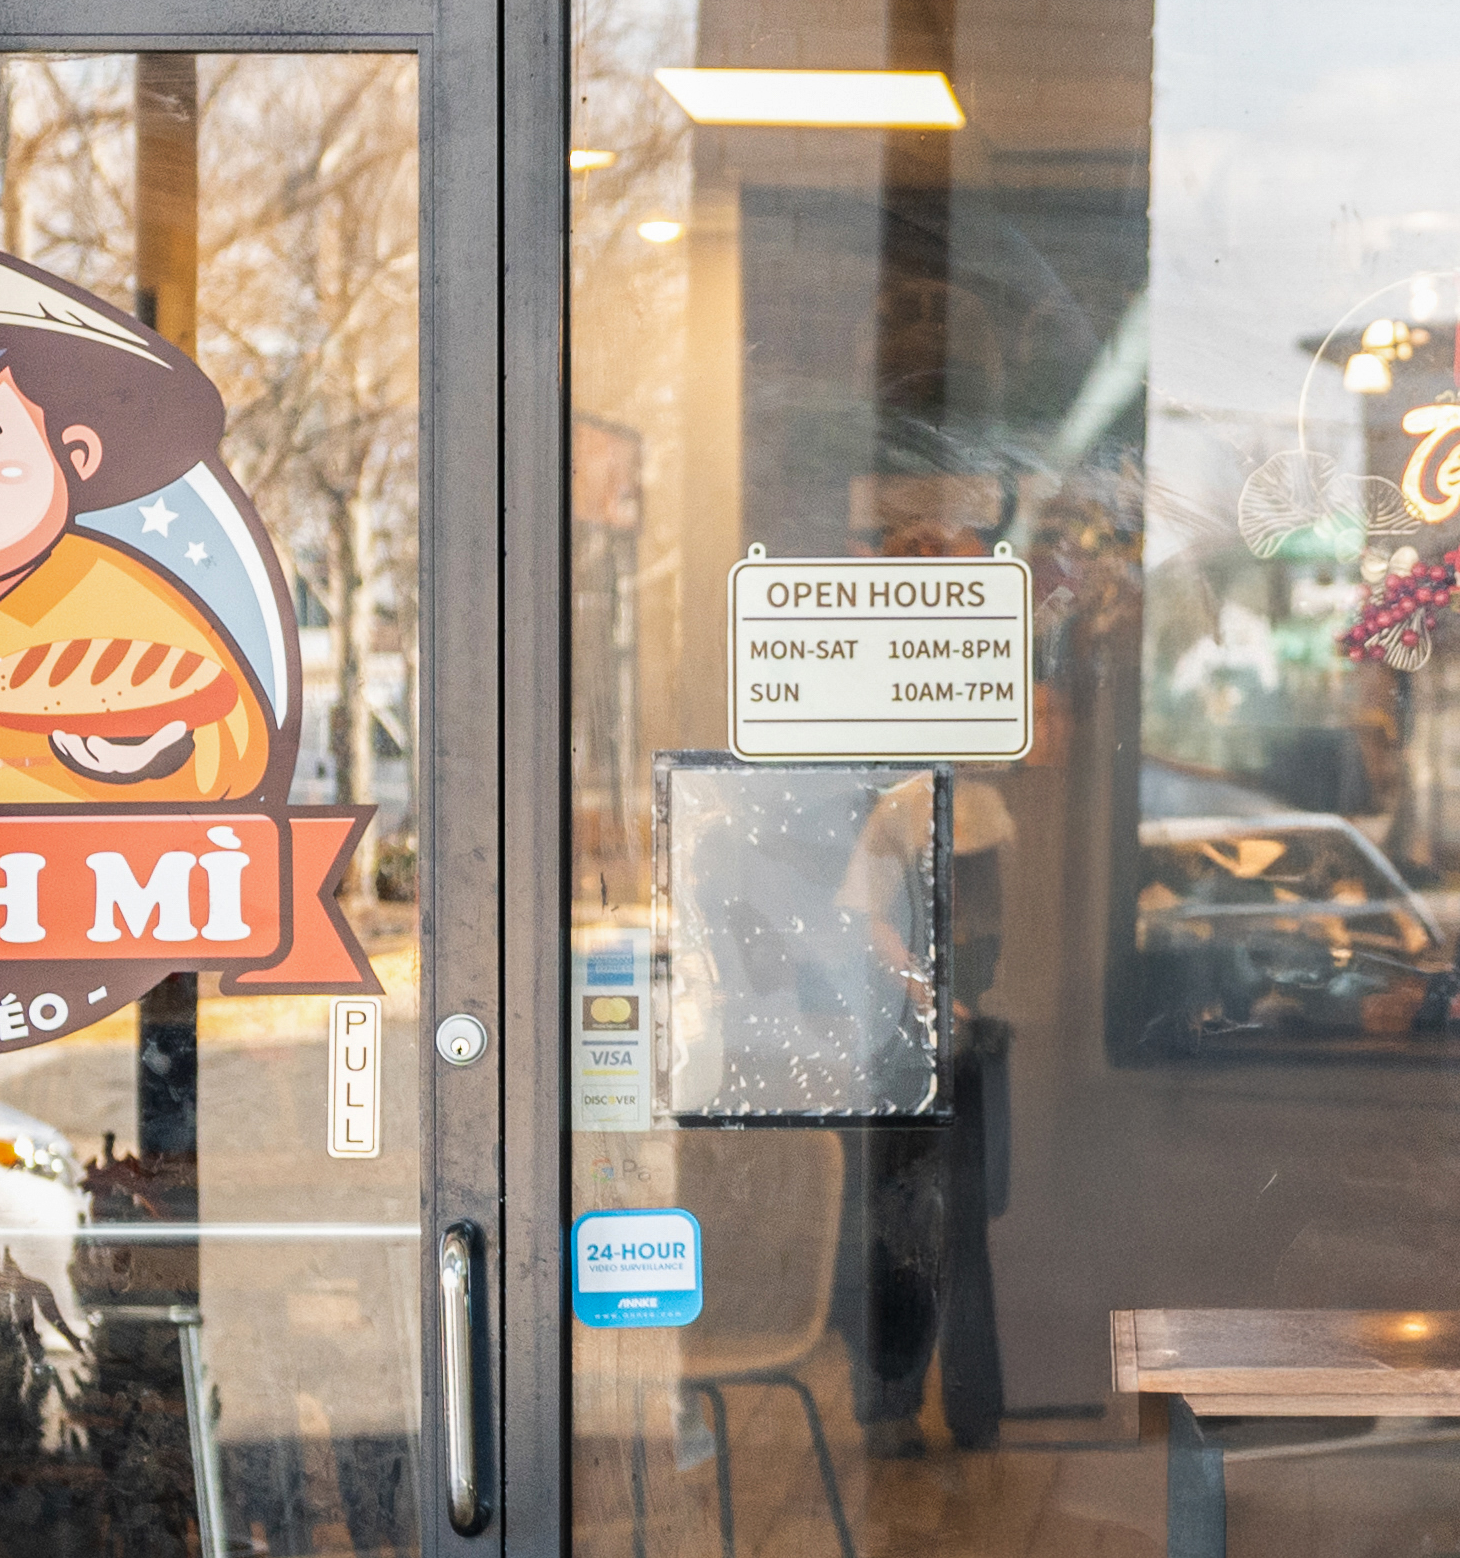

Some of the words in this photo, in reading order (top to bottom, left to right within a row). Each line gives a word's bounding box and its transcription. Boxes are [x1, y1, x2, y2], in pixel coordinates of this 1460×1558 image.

[766, 581, 858, 608] OPEN
[868, 580, 986, 608] HOURS
[749, 639, 859, 660] MON-SAT
[888, 639, 1012, 660] 10AM-8PM
[749, 682, 800, 703] SUN
[890, 681, 1014, 703] 10AM-7PM
[85, 824, 252, 944] MÌ
[590, 1050, 633, 1066] VISA
[344, 1010, 368, 1144] PULL
[584, 1094, 637, 1106] DISCOVER
[586, 1242, 686, 1262] 24-HOUR
[589, 1263, 618, 1273] VIDEO
[620, 1262, 684, 1272] SURVEILLANCE
